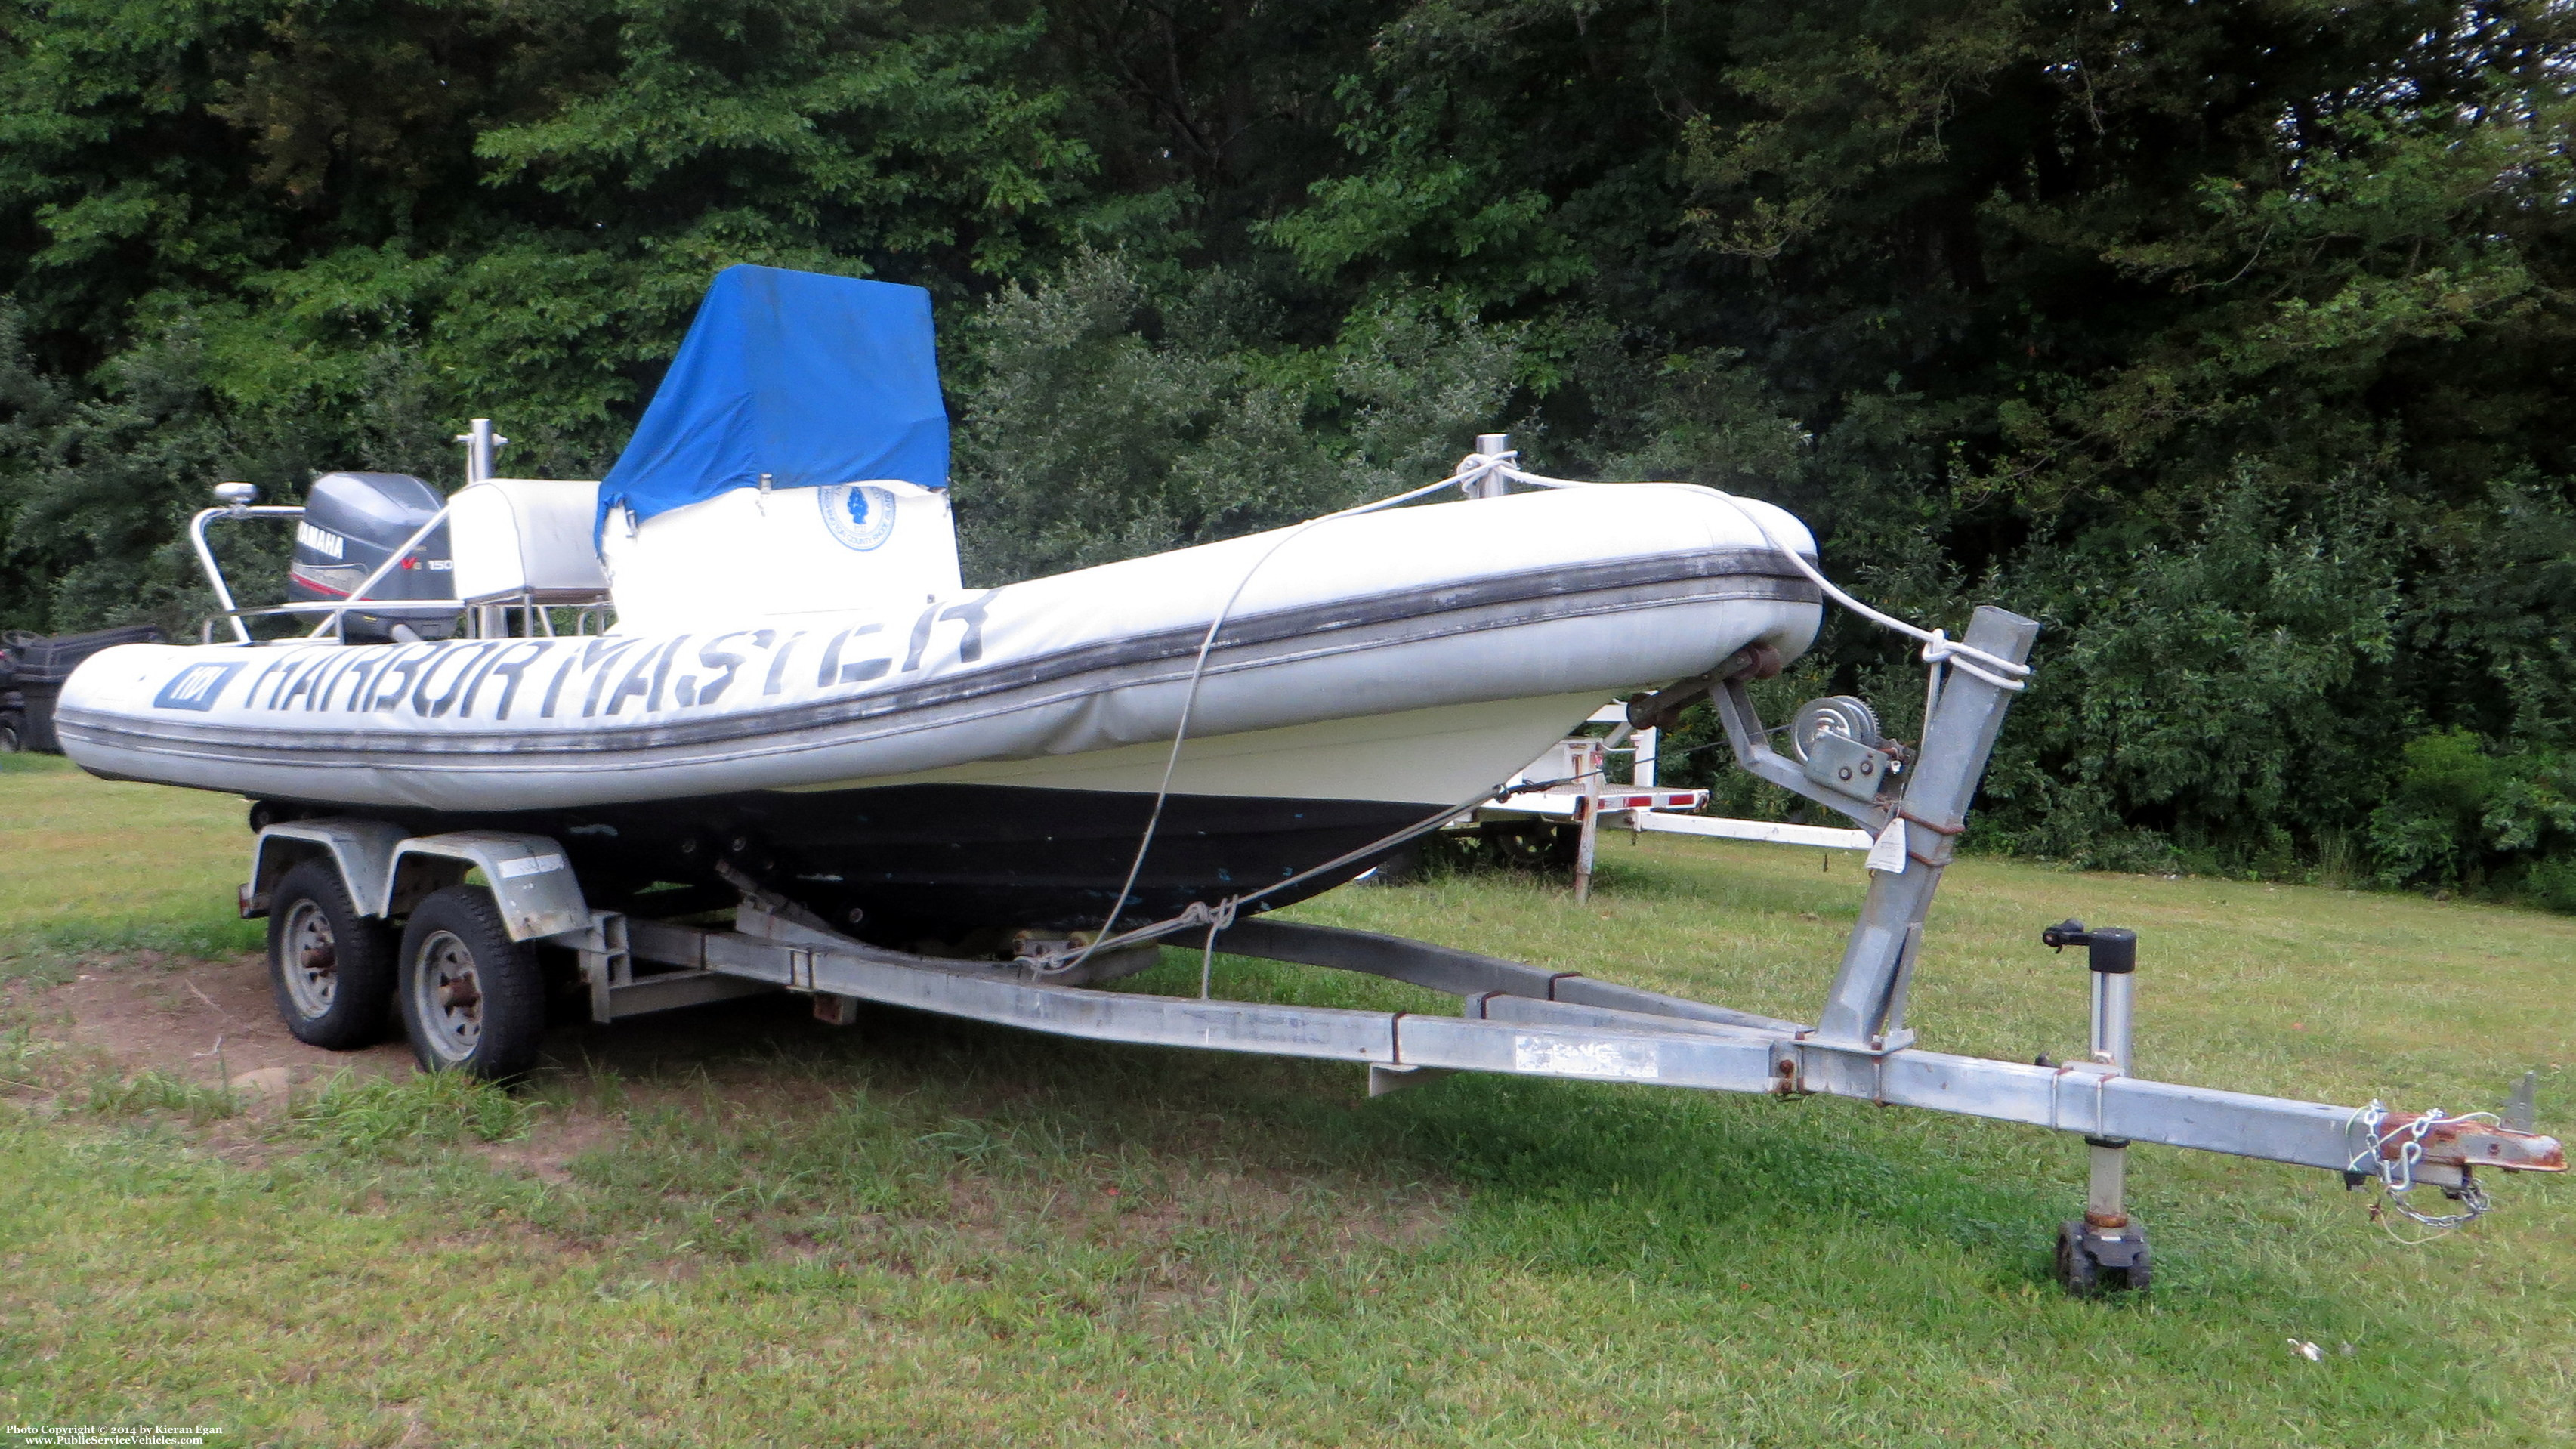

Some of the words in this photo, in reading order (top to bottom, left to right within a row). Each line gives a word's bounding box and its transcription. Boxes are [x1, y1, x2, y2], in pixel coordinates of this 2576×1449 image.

[297, 520, 344, 560] YAMAHA
[845, 533, 873, 545] COUNTY
[427, 559, 453, 570] 150
